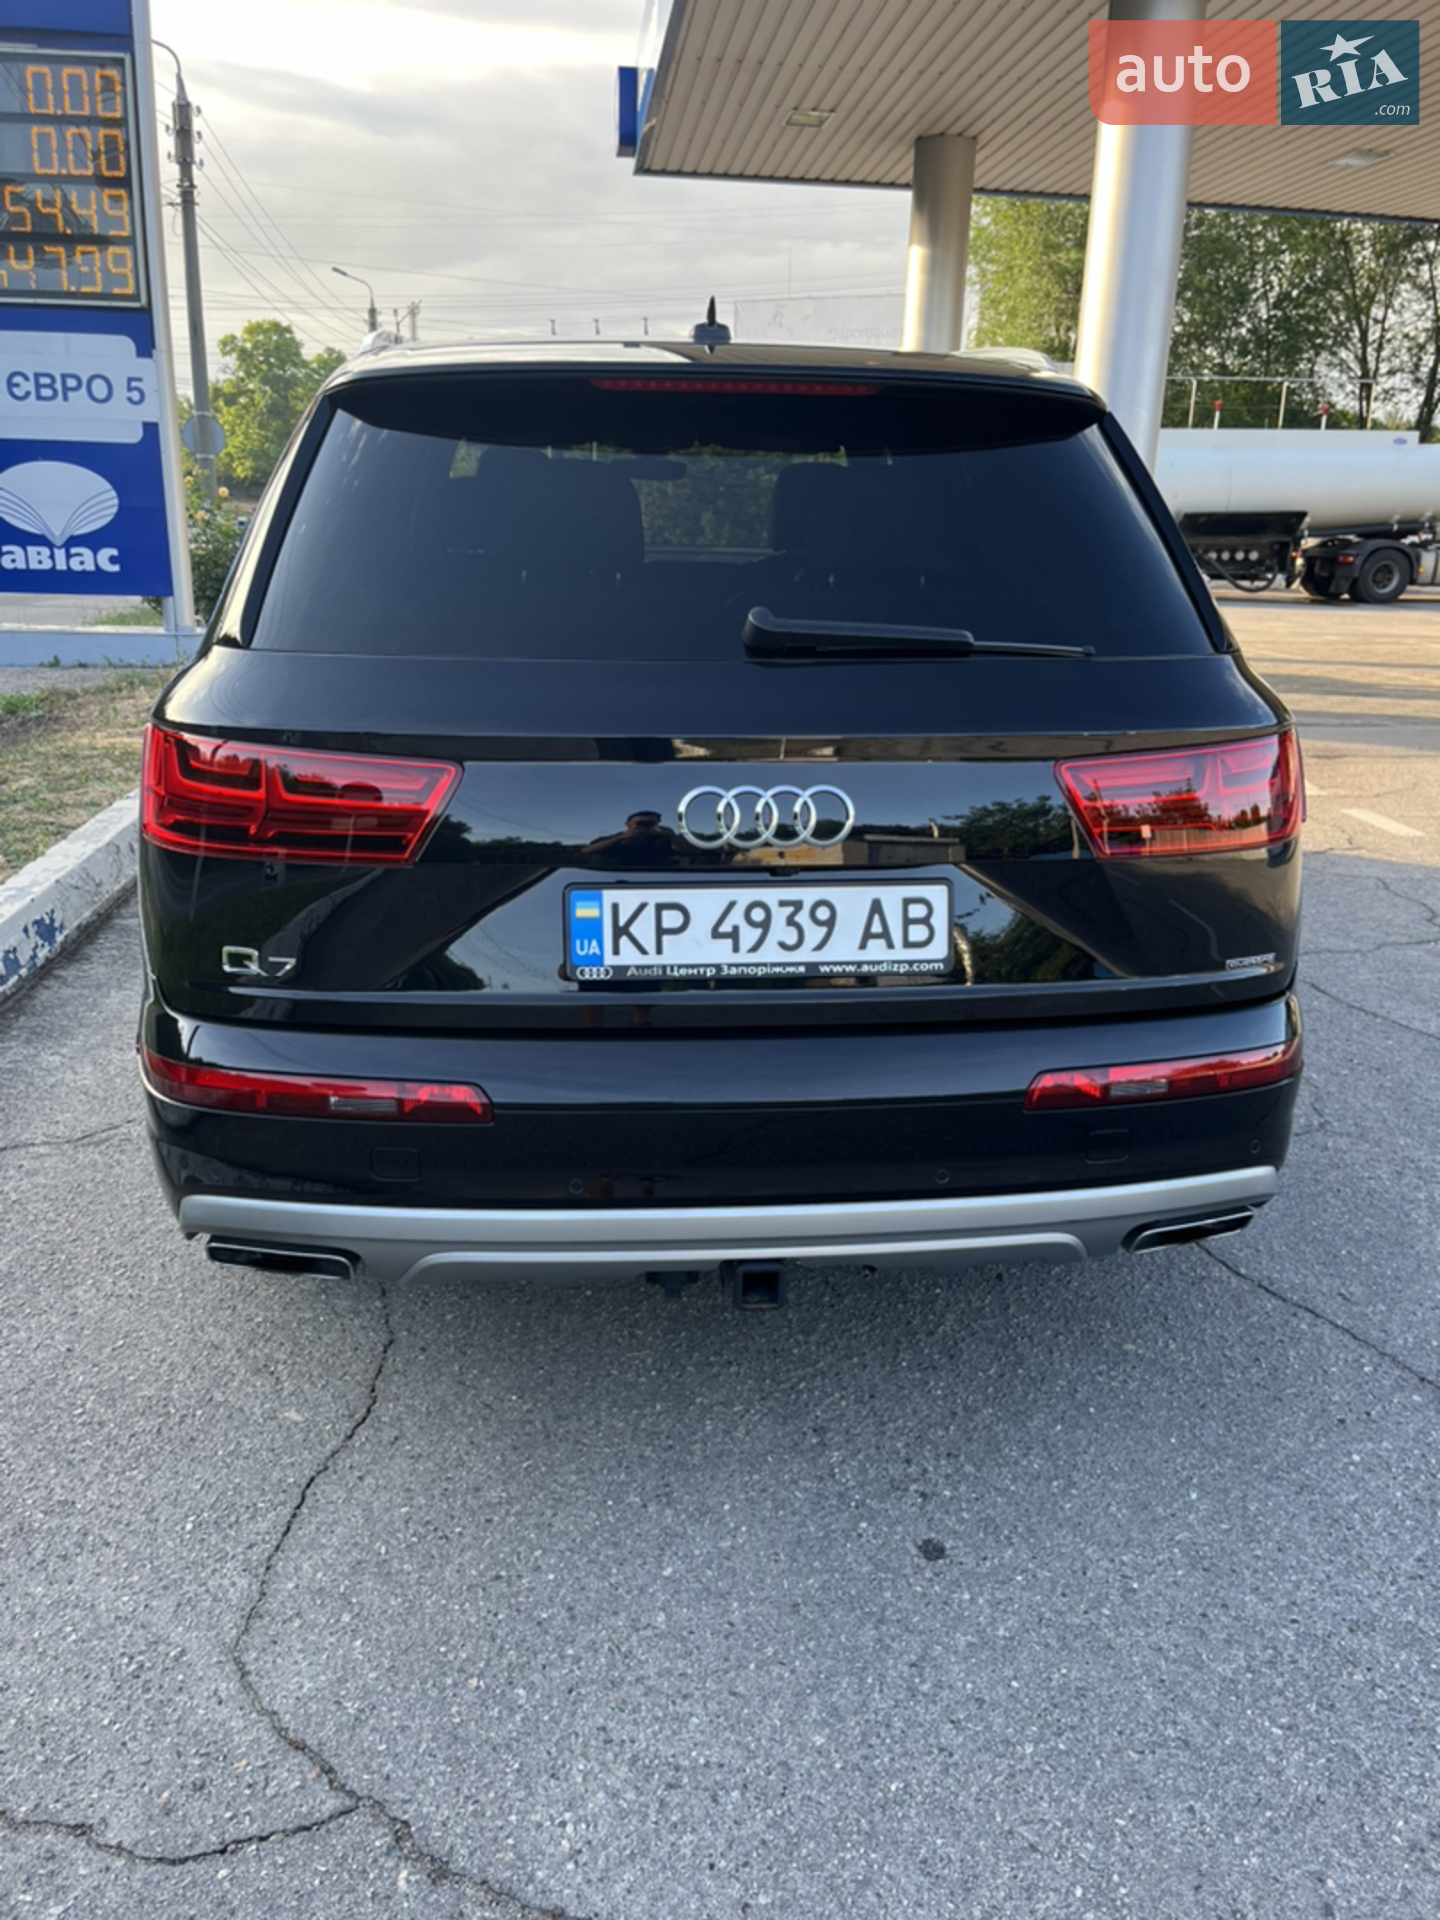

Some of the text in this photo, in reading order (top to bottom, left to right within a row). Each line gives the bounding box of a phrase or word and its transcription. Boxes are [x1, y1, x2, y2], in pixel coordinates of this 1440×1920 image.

[25, 65, 122, 118] 0.00
[31, 126, 126, 178] 0.00
[3, 184, 131, 239] 54.49
[6, 370, 146, 406] ЄВРО 5
[576, 938, 601, 956] UA
[611, 896, 936, 956] KP 4939 AB
[222, 945, 297, 977] Q7
[626, 965, 663, 977] Audi
[666, 964, 716, 978] Центр
[818, 960, 944, 974] www.audizp.com
